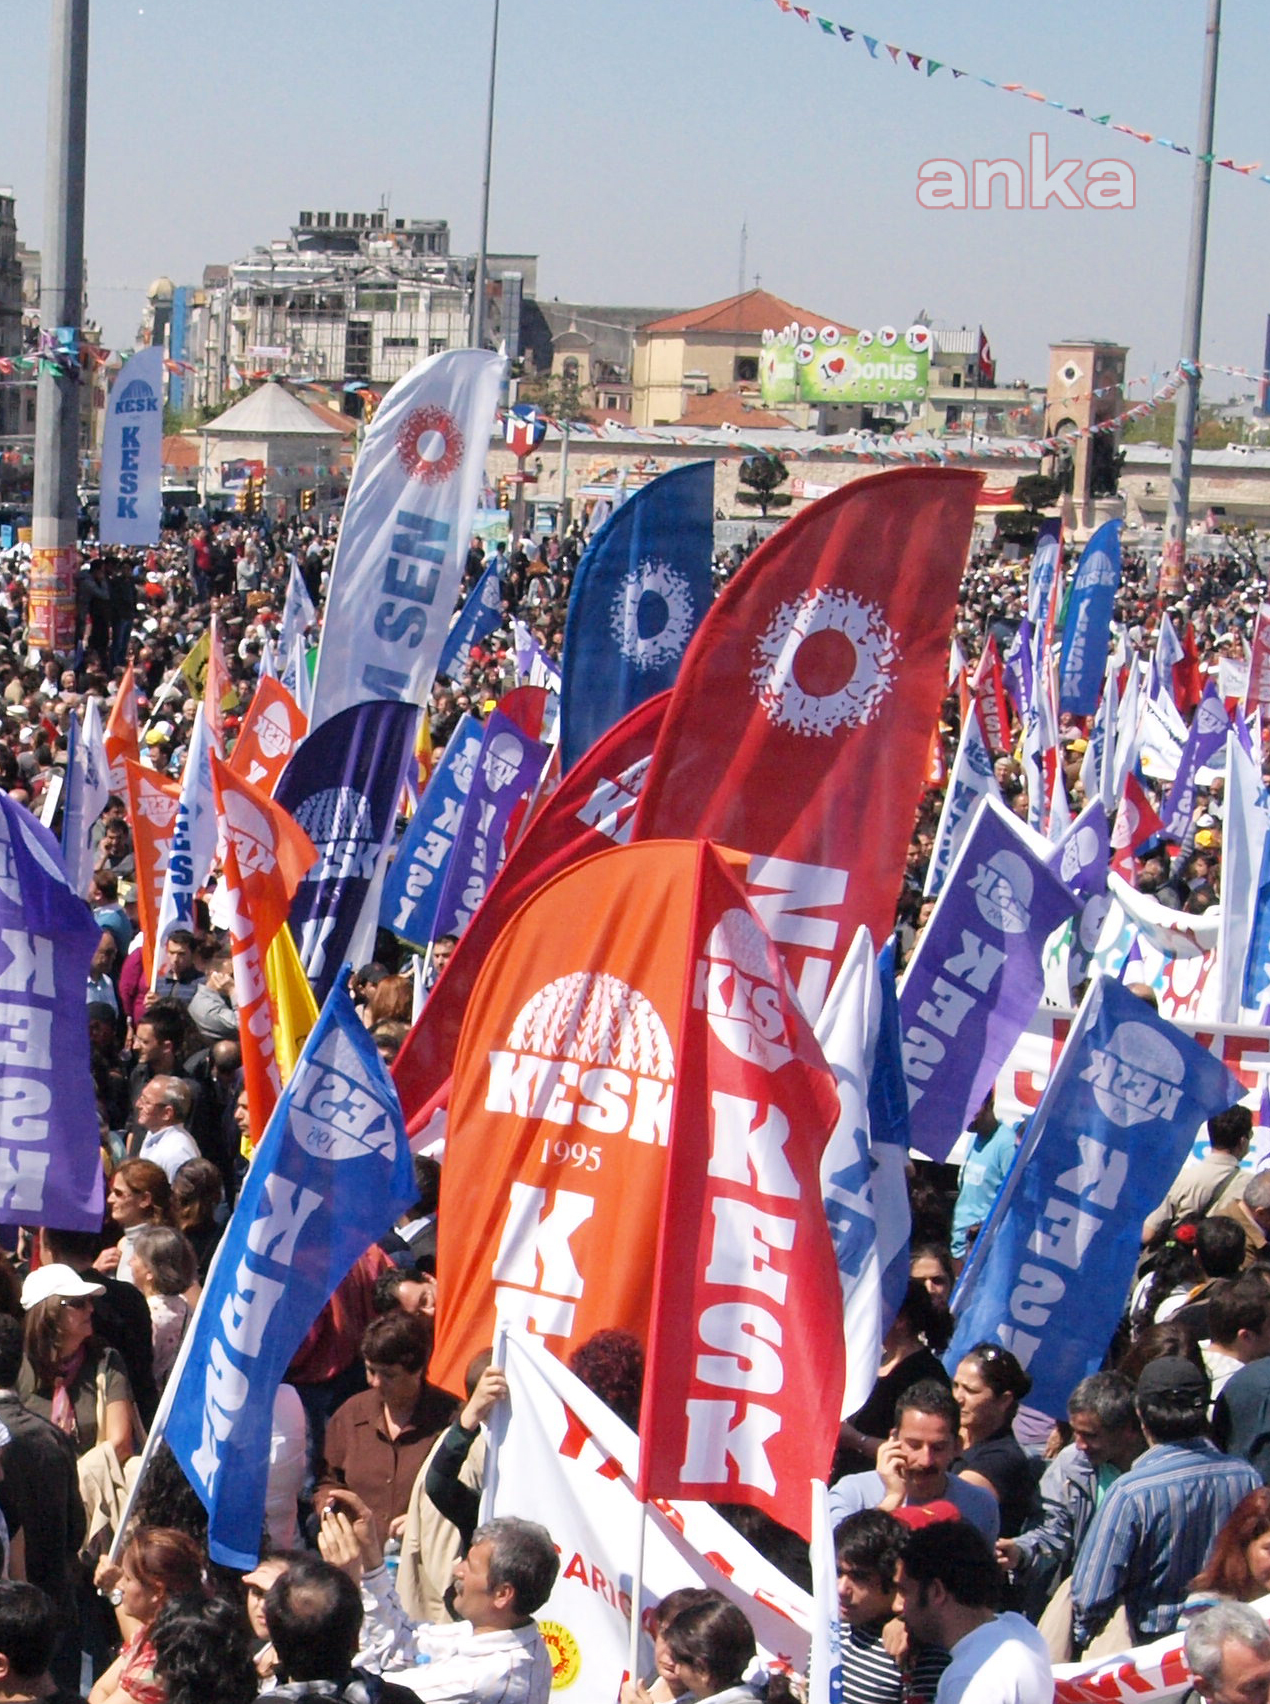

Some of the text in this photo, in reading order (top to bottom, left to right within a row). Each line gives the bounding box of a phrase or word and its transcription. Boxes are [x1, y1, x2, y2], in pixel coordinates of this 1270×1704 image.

[115, 397, 158, 414] KESK
[117, 426, 141, 519] KESK
[373, 509, 451, 649] SEN
[304, 841, 381, 882] ESK
[692, 957, 790, 1049] KES
[483, 1049, 675, 1148] KESK
[540, 1137, 603, 1173] 1995
[491, 1180, 595, 1348] KE
[678, 1090, 802, 1499] KESK
